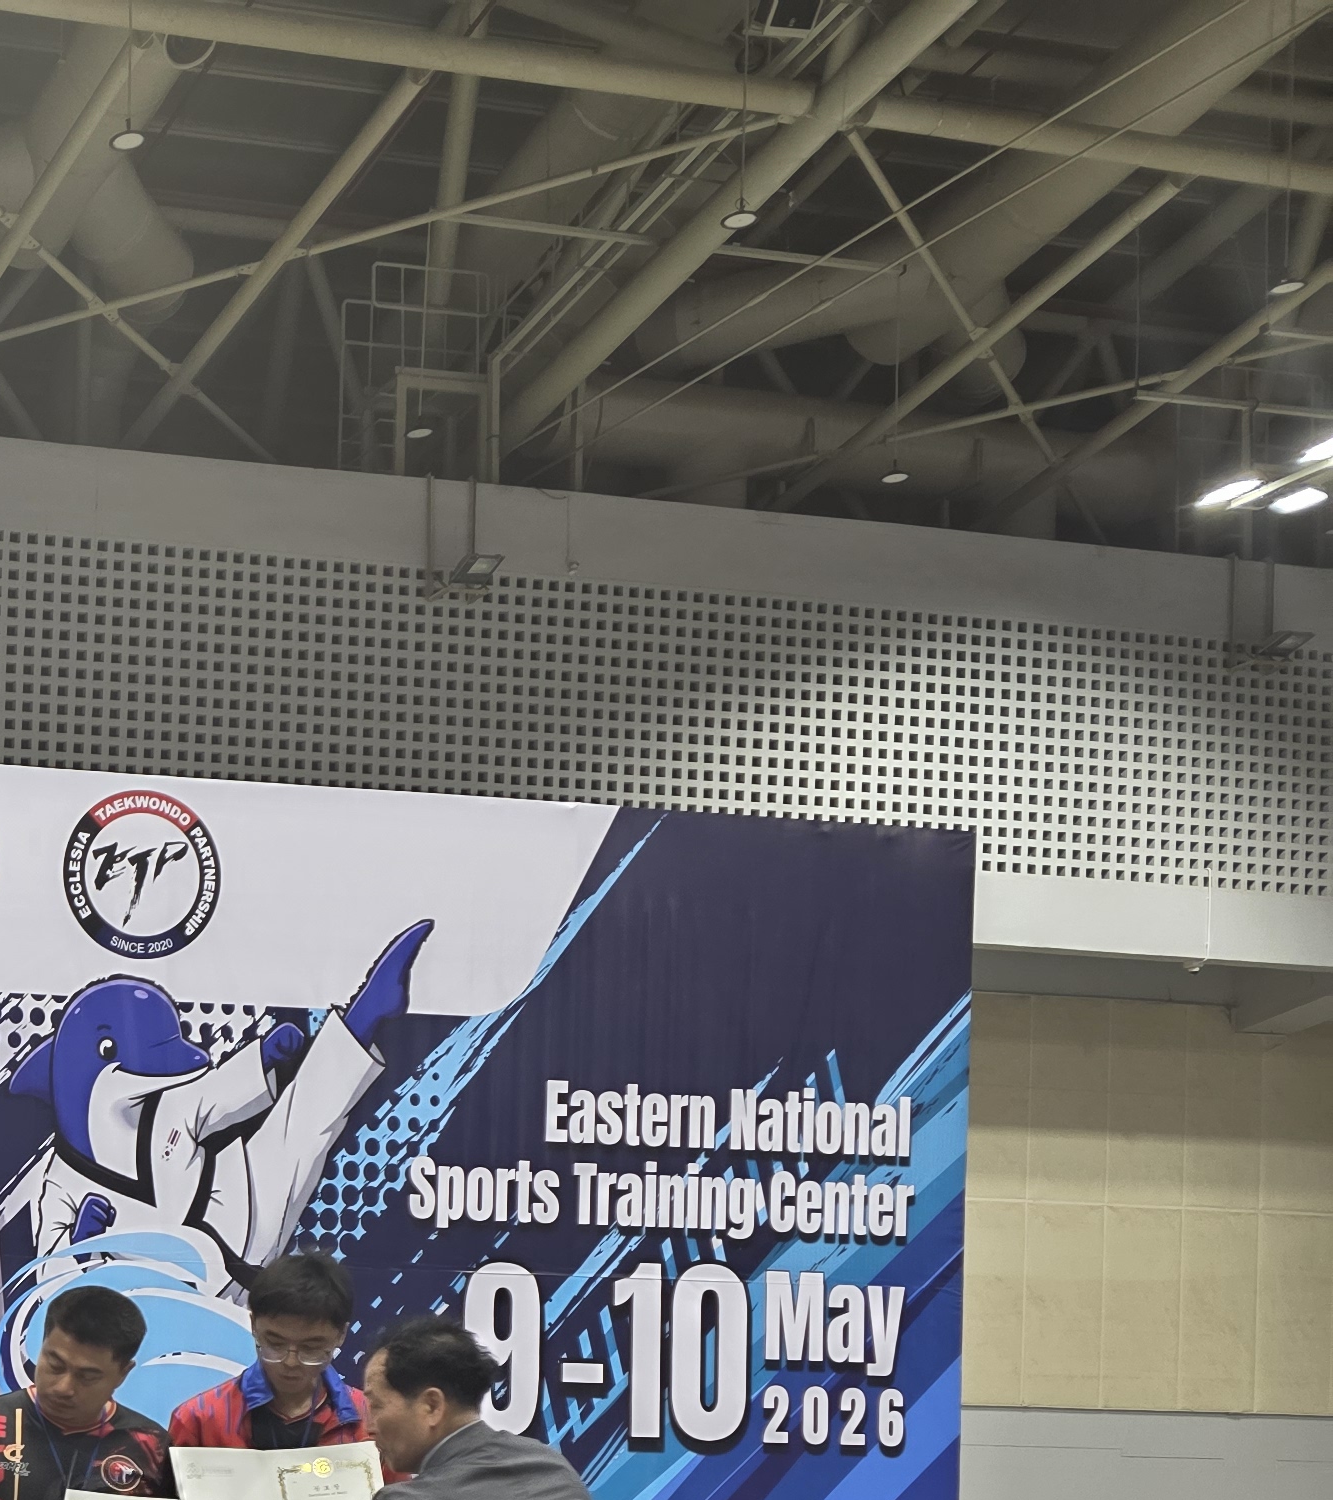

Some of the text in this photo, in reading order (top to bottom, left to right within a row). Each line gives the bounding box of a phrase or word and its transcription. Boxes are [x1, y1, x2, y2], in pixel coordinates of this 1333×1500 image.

[94, 795, 191, 826] TAEKWONDO
[68, 831, 92, 919] ECCLESIA
[185, 826, 216, 936] PARTNERSHIP
[110, 935, 173, 953] SINCE 2020
[544, 1080, 912, 1157] Eastern National
[408, 1157, 915, 1240] Sports Training Center
[764, 1271, 906, 1377] May
[763, 1385, 904, 1446] 2026
